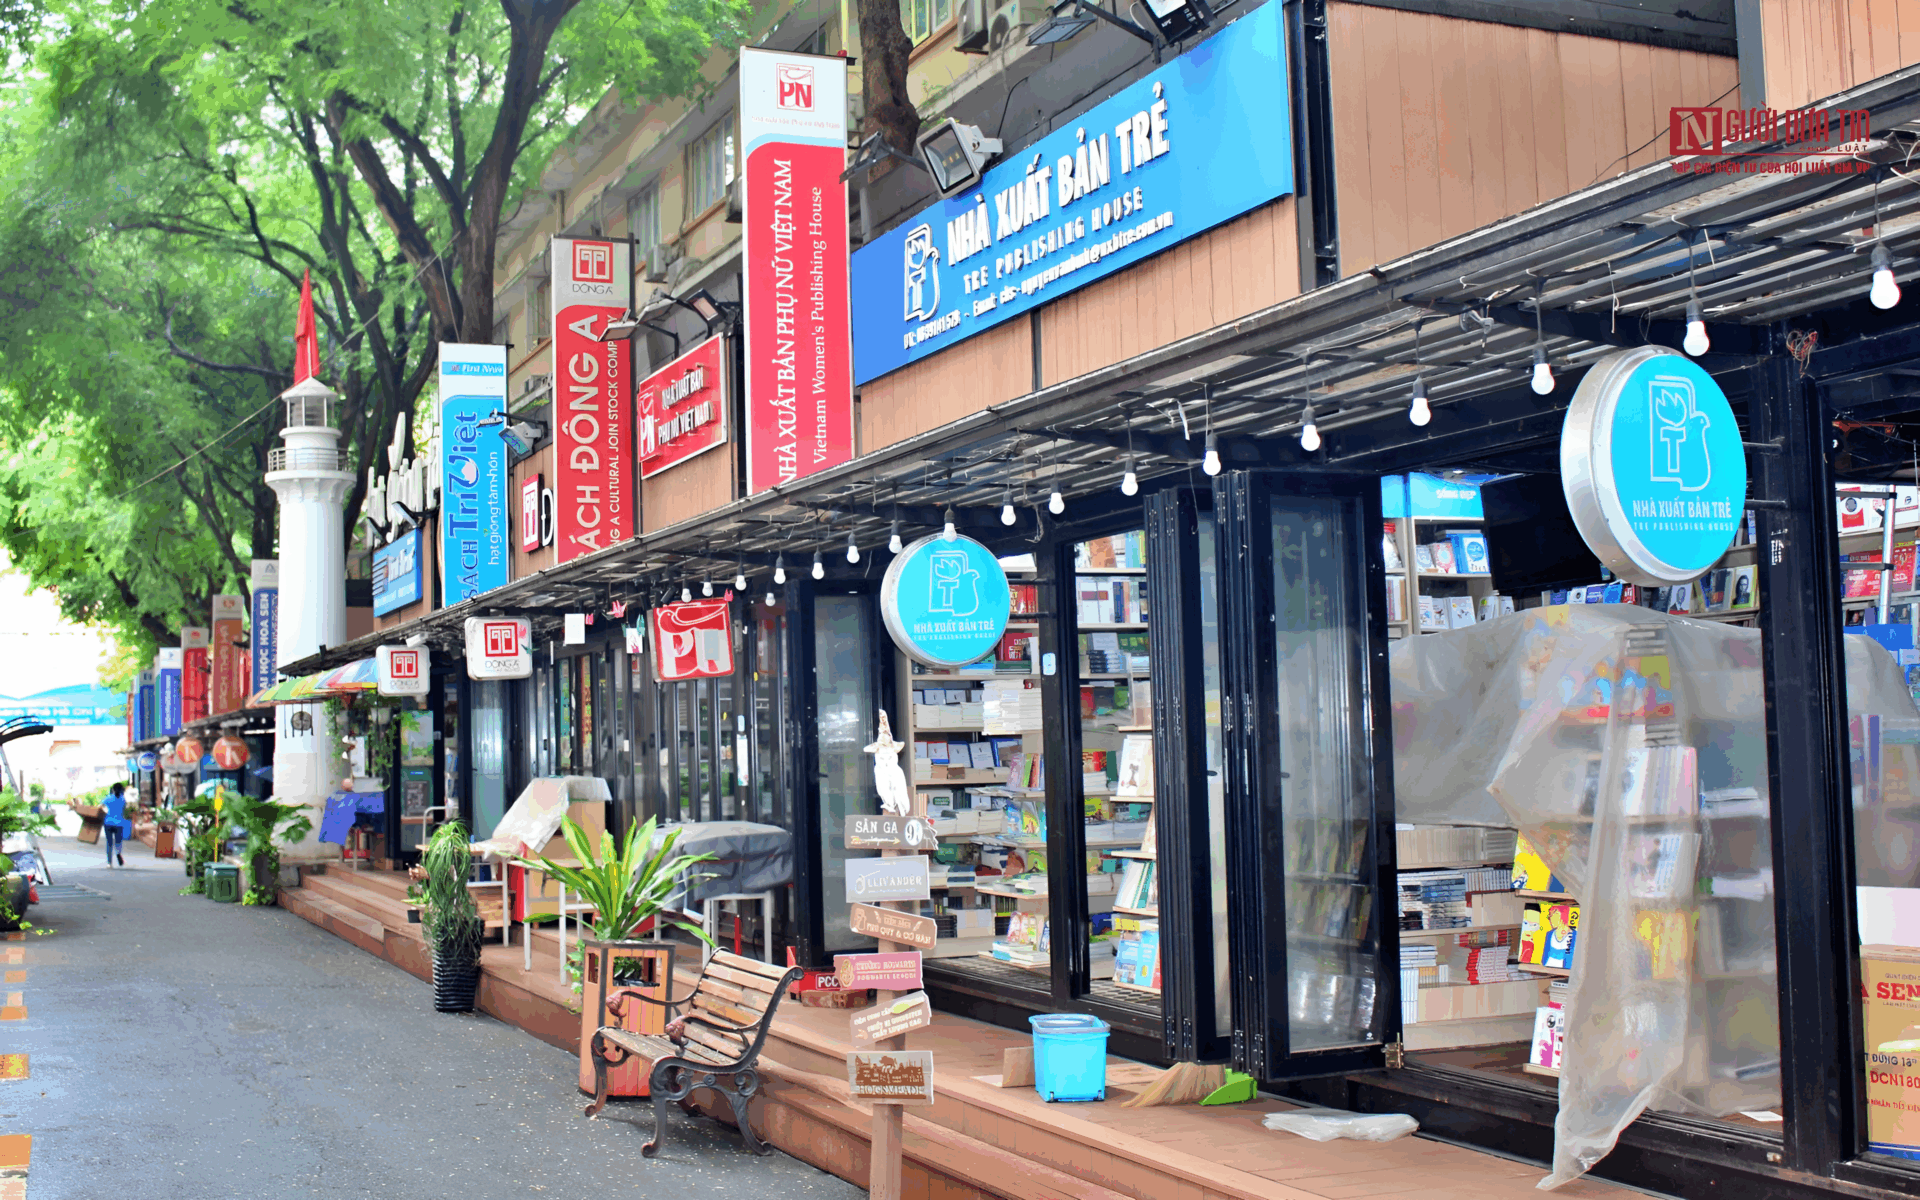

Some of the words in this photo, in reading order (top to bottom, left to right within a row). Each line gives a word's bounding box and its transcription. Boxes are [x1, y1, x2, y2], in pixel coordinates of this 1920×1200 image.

[779, 79, 812, 109] PN
[773, 159, 792, 207] NAM
[947, 193, 991, 266] NHÀ
[995, 153, 1052, 240] XUẤT
[1057, 127, 1110, 207] BẢN
[1115, 81, 1170, 174] TRẺ
[770, 210, 797, 254] VIỆT
[809, 187, 822, 236] House
[996, 217, 1085, 278] PUBLISHING
[1092, 186, 1143, 231] HOUSE
[771, 256, 794, 289] NỮ
[809, 241, 827, 321] Publishing
[568, 314, 599, 342] A
[775, 293, 798, 336] PHỤ
[607, 314, 618, 378] COMPY
[772, 339, 795, 380] BẢN
[811, 325, 826, 394] Women's
[561, 352, 600, 473] ĐÔNG
[608, 381, 619, 421] STOCK
[769, 384, 796, 438] XUẤT
[609, 424, 619, 453] JOIN
[813, 400, 827, 464] Vietnam
[610, 454, 620, 513] CULTURAL
[773, 441, 797, 486] NHÀ
[568, 486, 601, 556] ÁCH
[1632, 497, 1657, 517] NHÀ
[1658, 496, 1685, 518] XUẤT
[1687, 496, 1710, 518] BẢN
[1711, 496, 1732, 518] TRẺ
[259, 592, 269, 617] SEN
[259, 619, 269, 646] HOA
[259, 649, 270, 674] HỌC
[883, 821, 899, 834] GA
